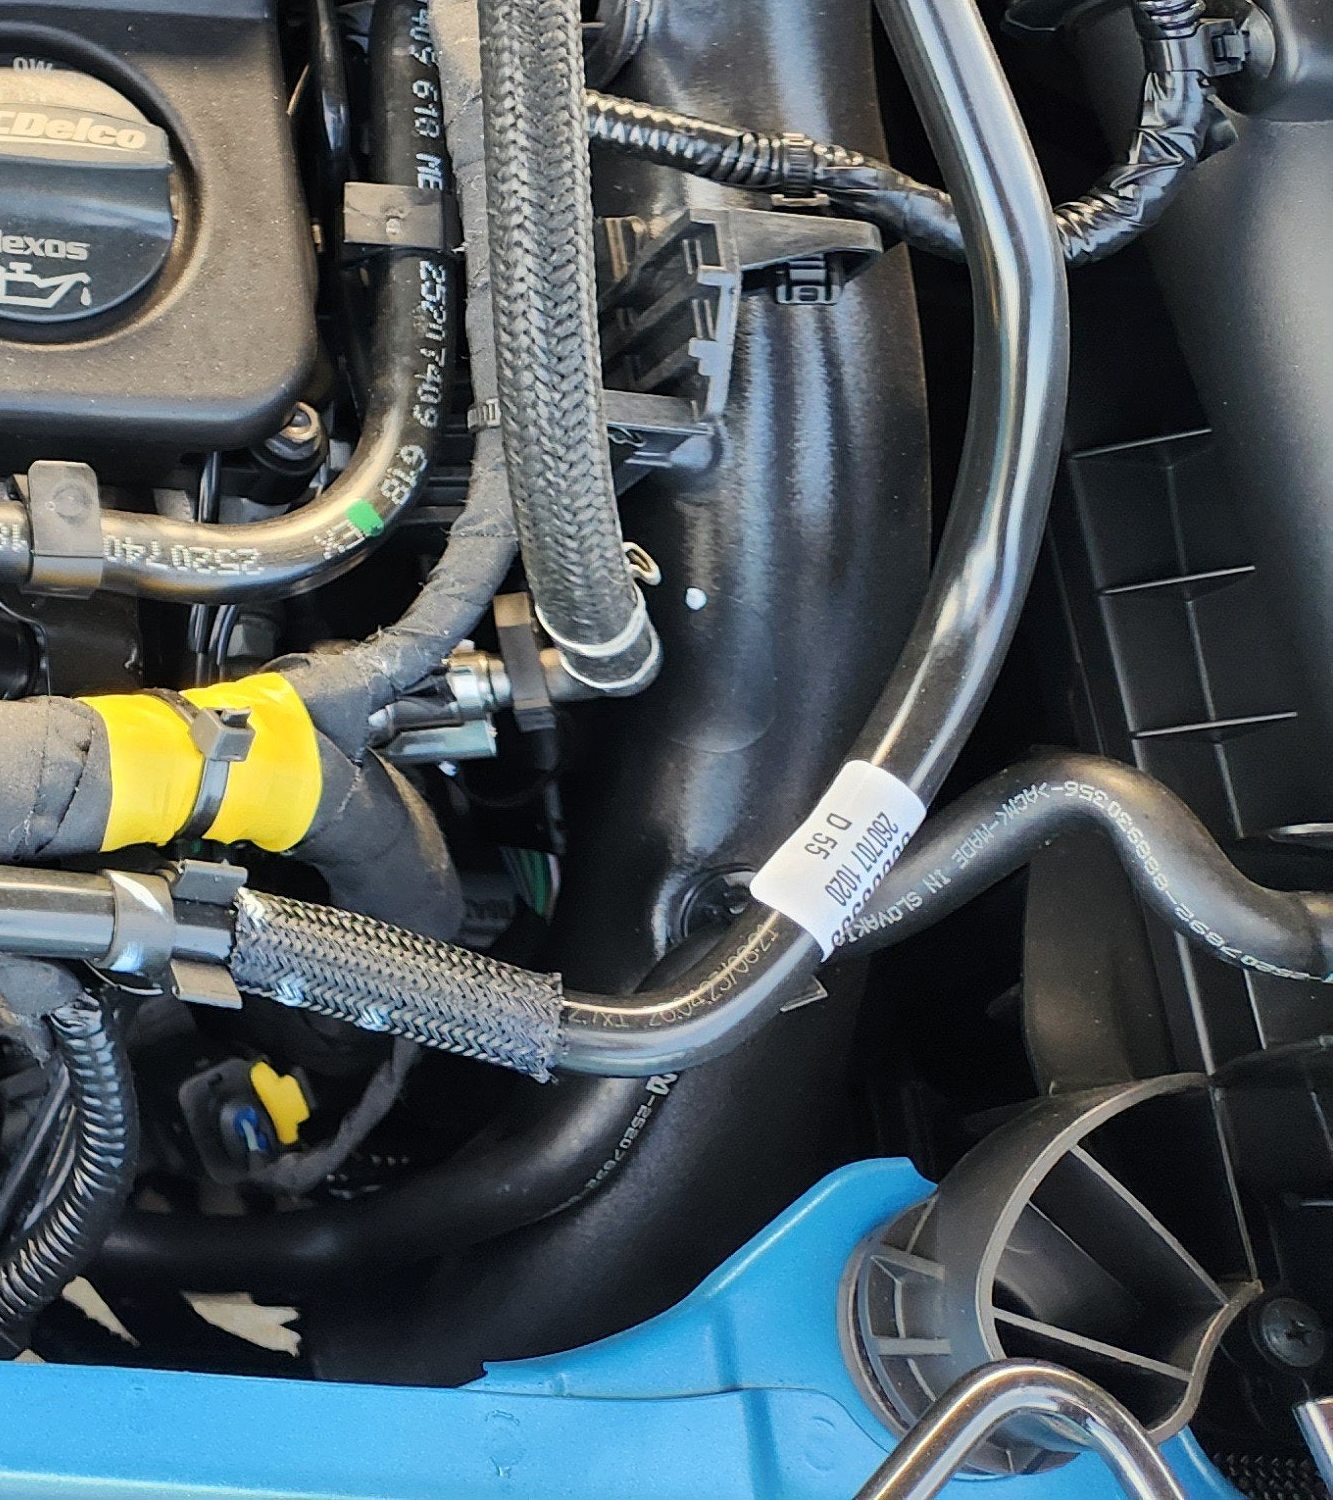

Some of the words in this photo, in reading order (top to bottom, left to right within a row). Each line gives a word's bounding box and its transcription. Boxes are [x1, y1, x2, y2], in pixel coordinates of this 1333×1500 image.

[416, 152, 443, 190] ME
[381, 444, 427, 505] 618
[826, 812, 853, 831] D
[851, 811, 899, 872] 260707
[804, 832, 838, 860] 55
[824, 863, 863, 907] 1020
